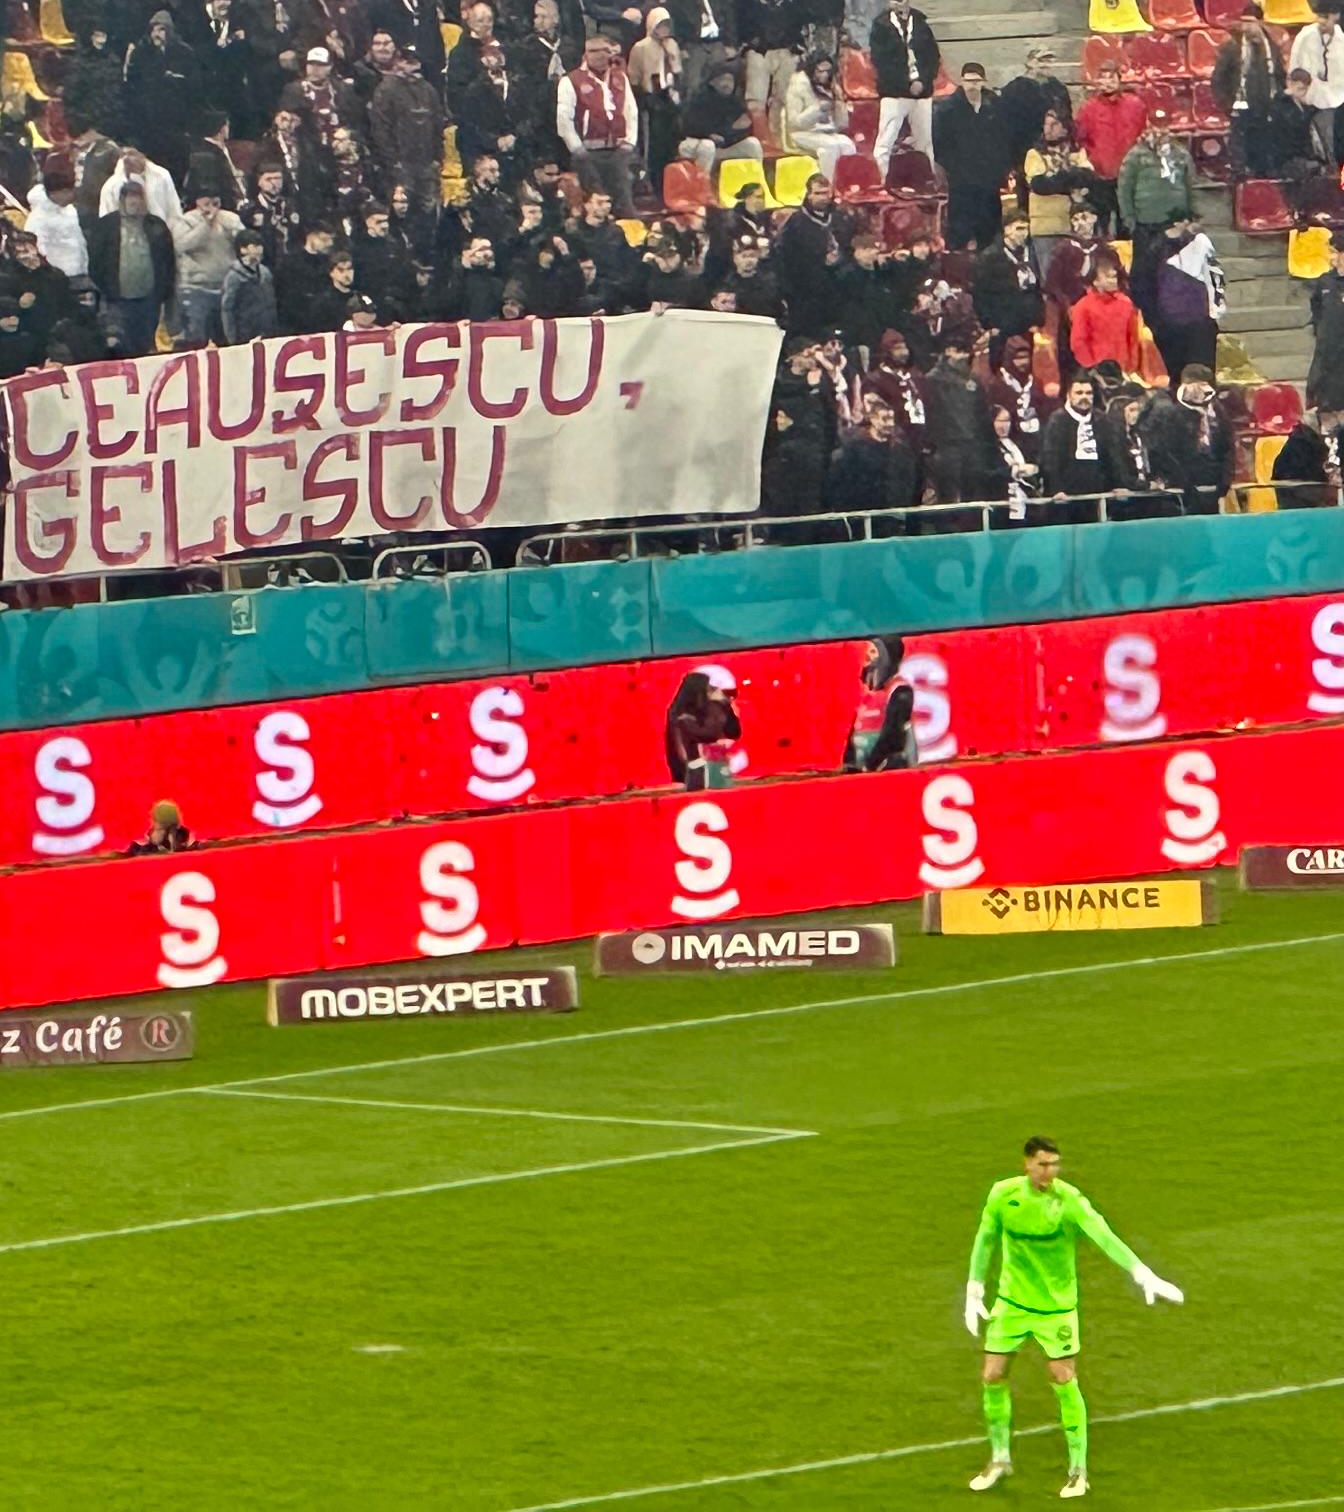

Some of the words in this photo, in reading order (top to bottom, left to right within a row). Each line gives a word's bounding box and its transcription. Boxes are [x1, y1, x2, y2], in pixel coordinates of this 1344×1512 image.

[902, 652, 950, 744] S
[1105, 635, 1159, 720] S
[255, 711, 314, 802] S
[470, 687, 528, 777] S
[35, 737, 95, 828] S
[922, 775, 977, 865] S
[1166, 751, 1219, 839] S
[421, 841, 478, 933] S
[674, 802, 731, 892] S
[160, 872, 219, 964] S
[670, 929, 860, 960] IMAMED
[1023, 887, 1160, 913] BINANCE
[35, 1014, 123, 1054] Café
[300, 977, 549, 1019] MOBEXPERT
